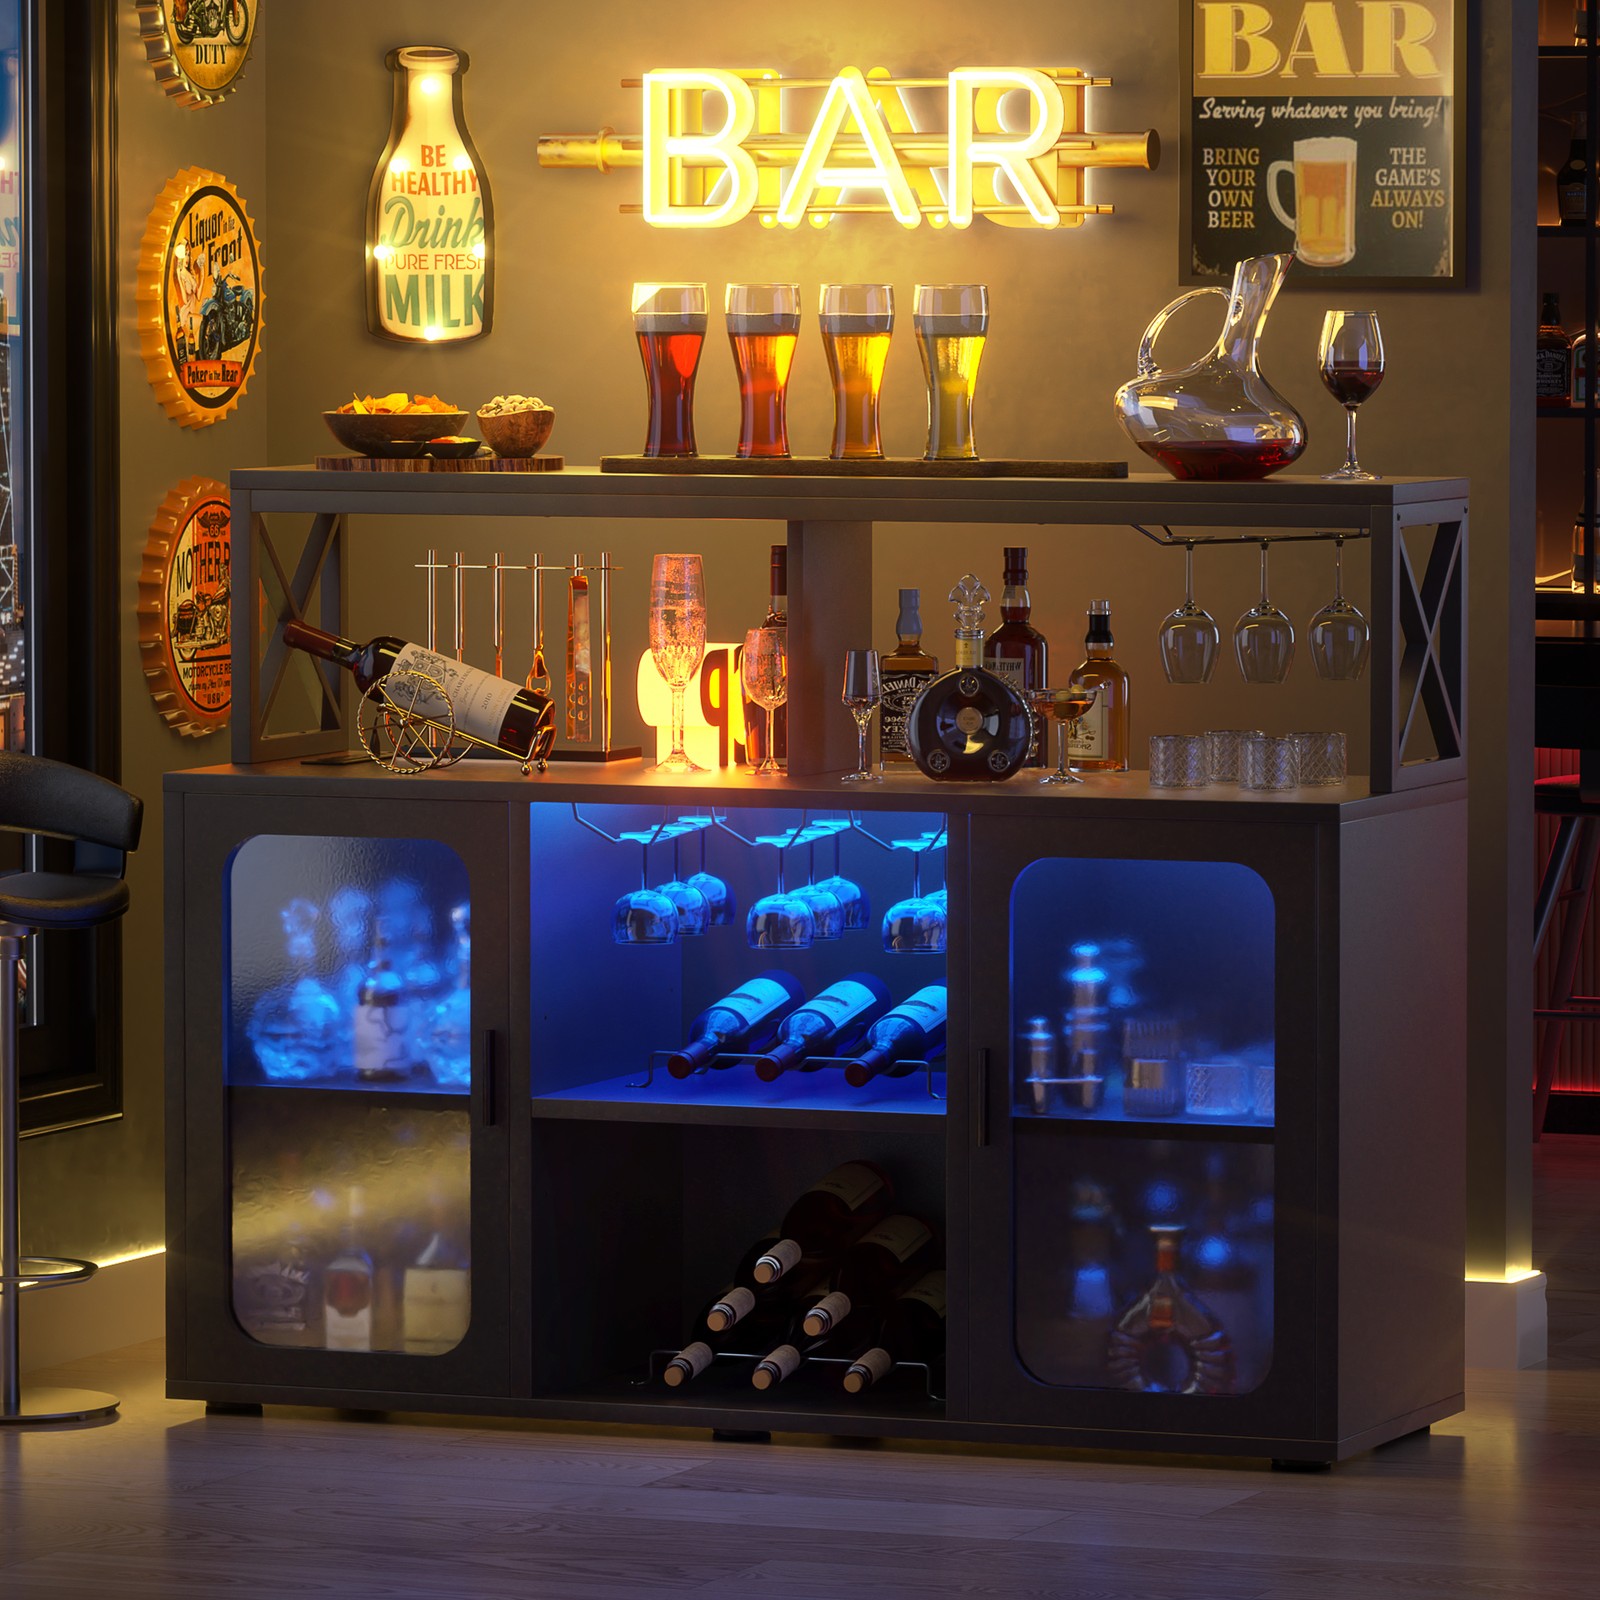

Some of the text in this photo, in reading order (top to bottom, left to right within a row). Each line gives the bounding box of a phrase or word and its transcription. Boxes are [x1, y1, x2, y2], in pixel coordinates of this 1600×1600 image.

[1197, 1, 1445, 79] BAR
[195, 44, 228, 65] DUTY
[1199, 97, 1443, 128] Serving whatever you bring!
[420, 144, 447, 168] BE
[641, 66, 1066, 229] BAR
[1202, 148, 1260, 166] BRING
[1389, 147, 1426, 165] THE
[392, 168, 479, 197] HEALTHY
[1206, 169, 1256, 186] YOUR
[1375, 169, 1440, 186] GAME'S
[1208, 190, 1254, 208] OWN
[1371, 190, 1445, 208] ALWAYS
[381, 195, 485, 249] Drink
[1207, 211, 1256, 229] BEER
[1391, 210, 1423, 229] ON!
[189, 210, 223, 252] Liquor
[208, 226, 242, 276] Front
[385, 274, 485, 328] MILK
[188, 365, 208, 384] Poker
[222, 364, 238, 383] Rear
[209, 524, 219, 536] 66
[176, 541, 220, 598] MOTHER
[183, 663, 223, 679] MOTORCYCLE
[481, 692, 493, 710] 2010
